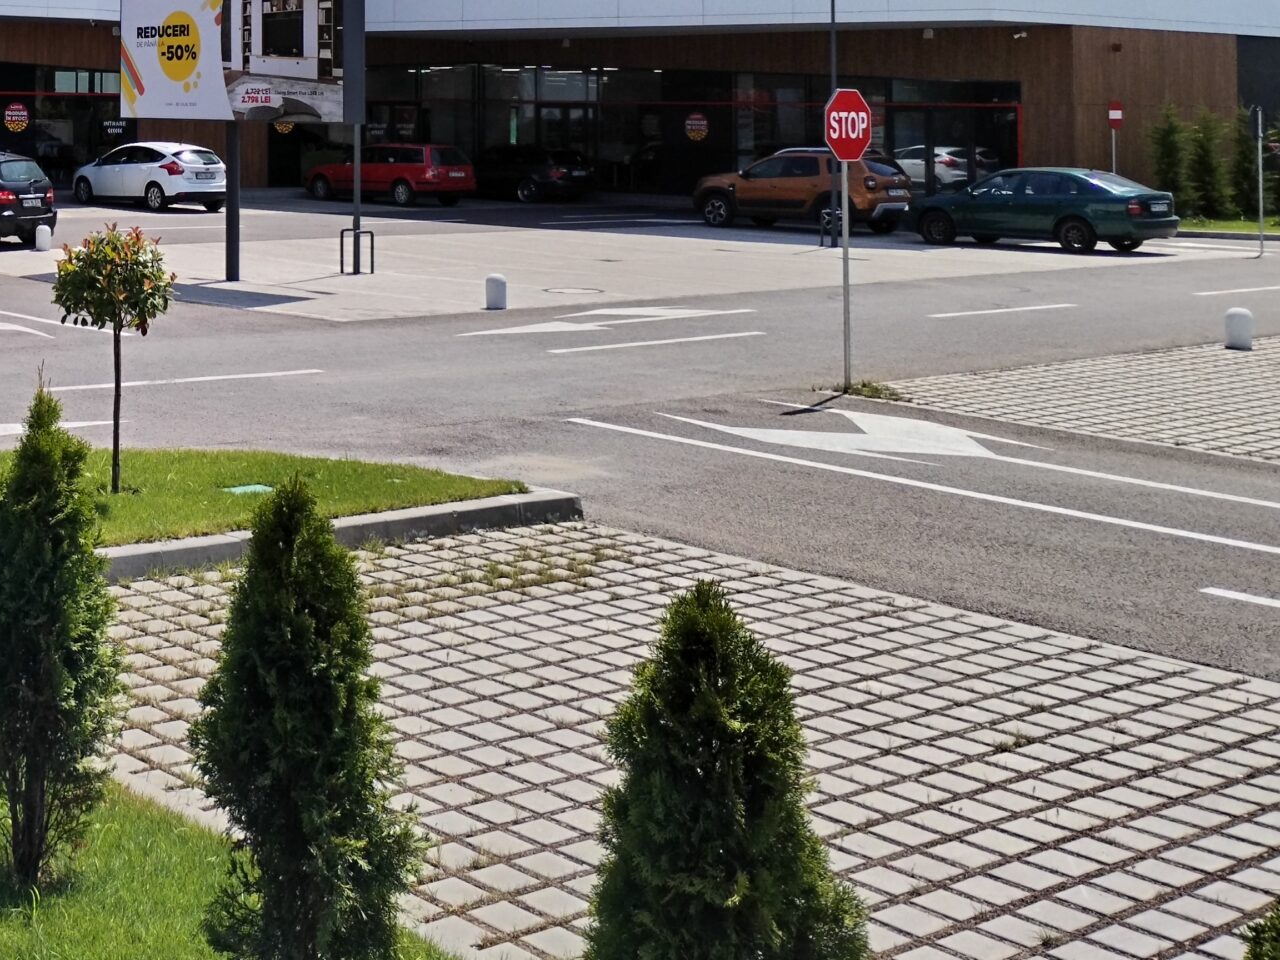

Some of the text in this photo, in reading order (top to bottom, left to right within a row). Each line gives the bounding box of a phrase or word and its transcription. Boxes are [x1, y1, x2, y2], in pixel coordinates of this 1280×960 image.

[137, 24, 190, 39] REDUCERI
[161, 44, 197, 61] -50%
[260, 96, 271, 104] LEI
[829, 111, 868, 139] STOP
